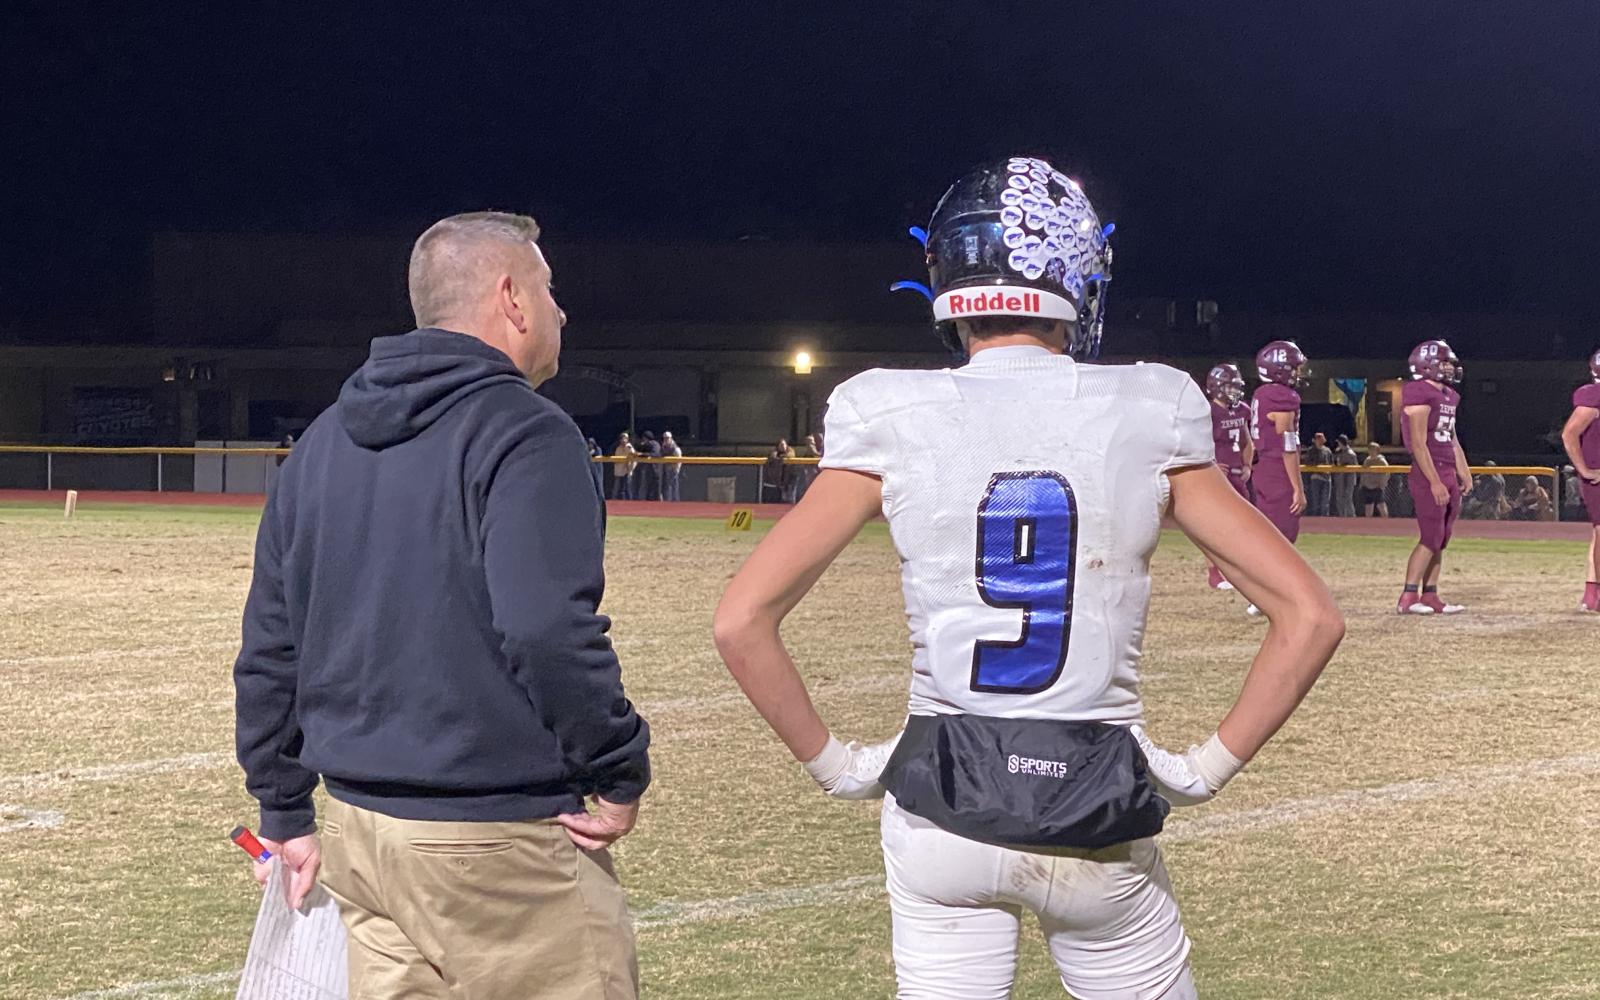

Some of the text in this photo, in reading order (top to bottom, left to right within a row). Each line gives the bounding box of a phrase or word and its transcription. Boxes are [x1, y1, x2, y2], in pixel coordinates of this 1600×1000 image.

[949, 292, 1040, 314] Riddell
[1272, 349, 1287, 363] 12
[1228, 429, 1240, 452] 7
[730, 511, 747, 528] 10
[970, 470, 1078, 694] 9
[1020, 757, 1068, 774] SPORTS
[1021, 768, 1065, 779] UNLIMITED
